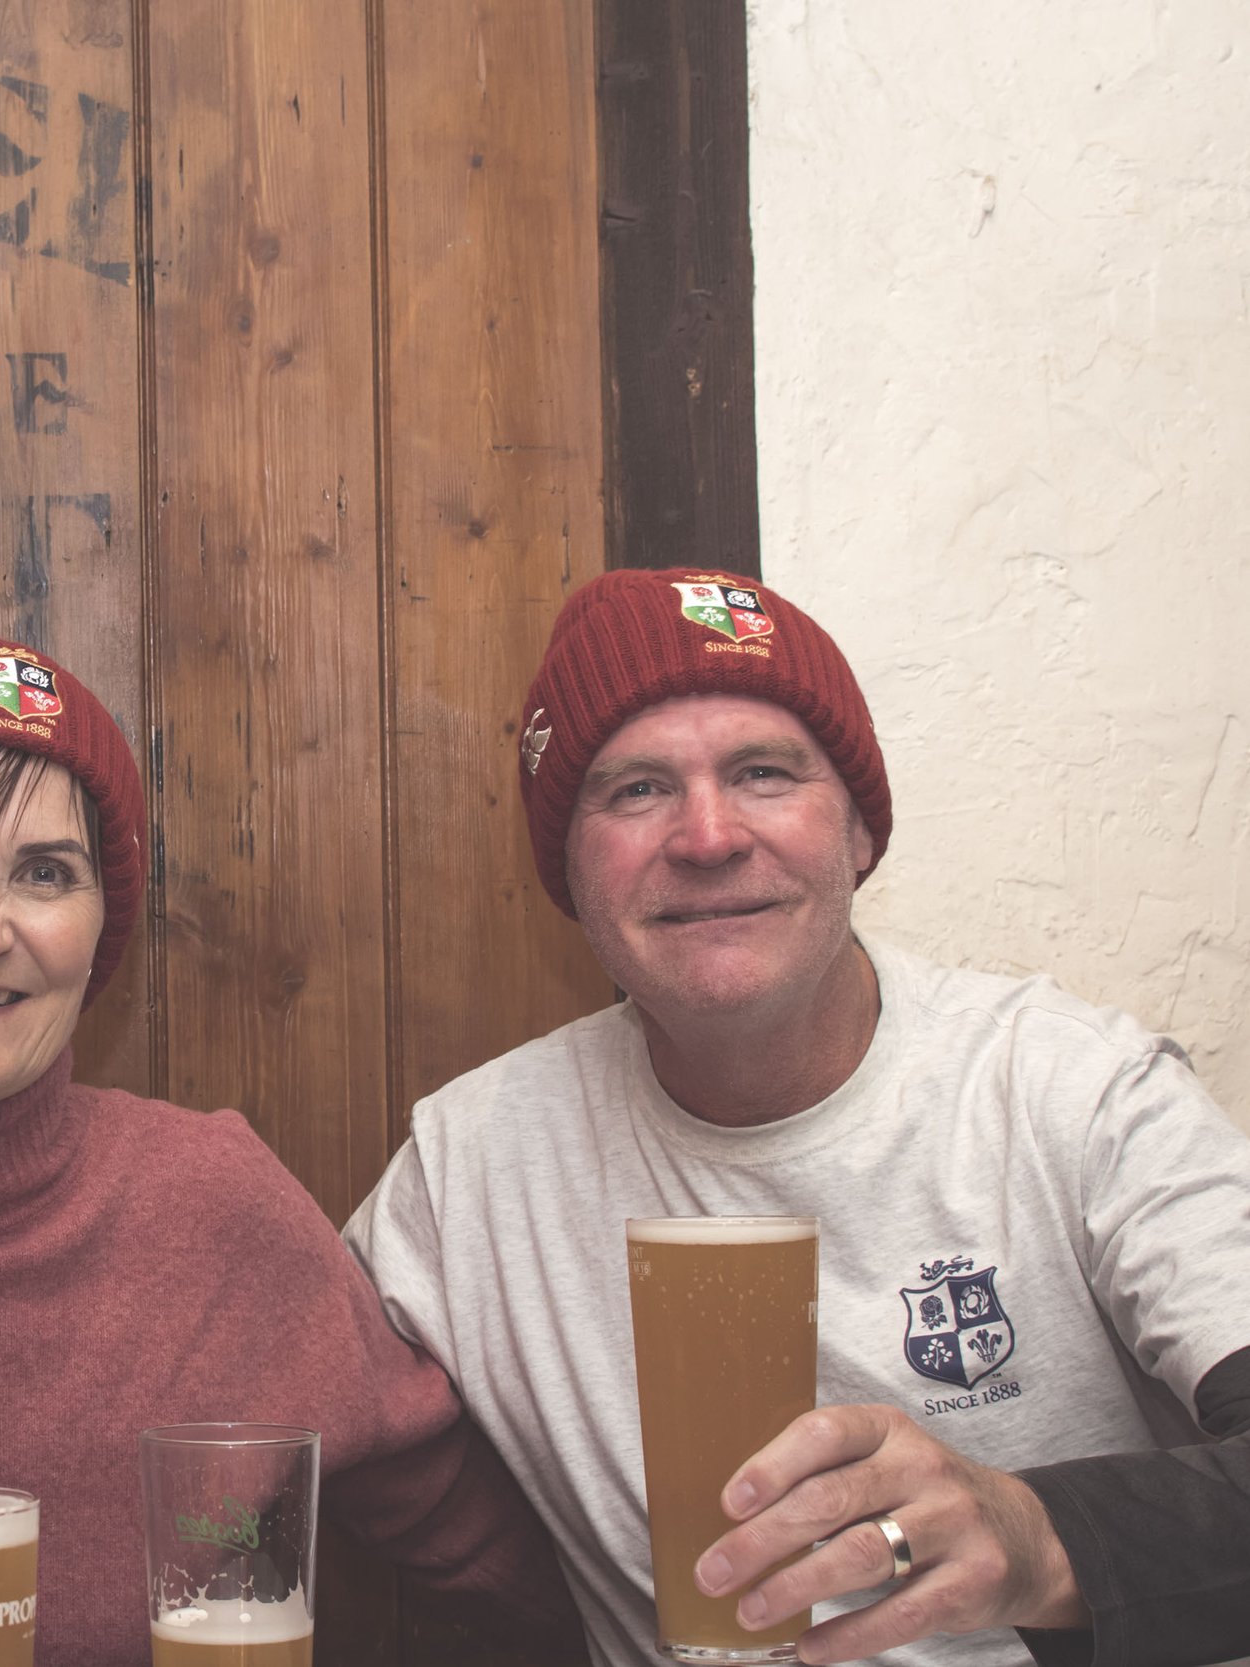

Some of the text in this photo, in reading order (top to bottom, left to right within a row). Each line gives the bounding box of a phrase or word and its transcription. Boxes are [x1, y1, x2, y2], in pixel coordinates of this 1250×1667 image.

[705, 641, 770, 658] SINCE 1888
[25, 723, 51, 739] 1888
[924, 1381, 1022, 1416] SINCE 1888
